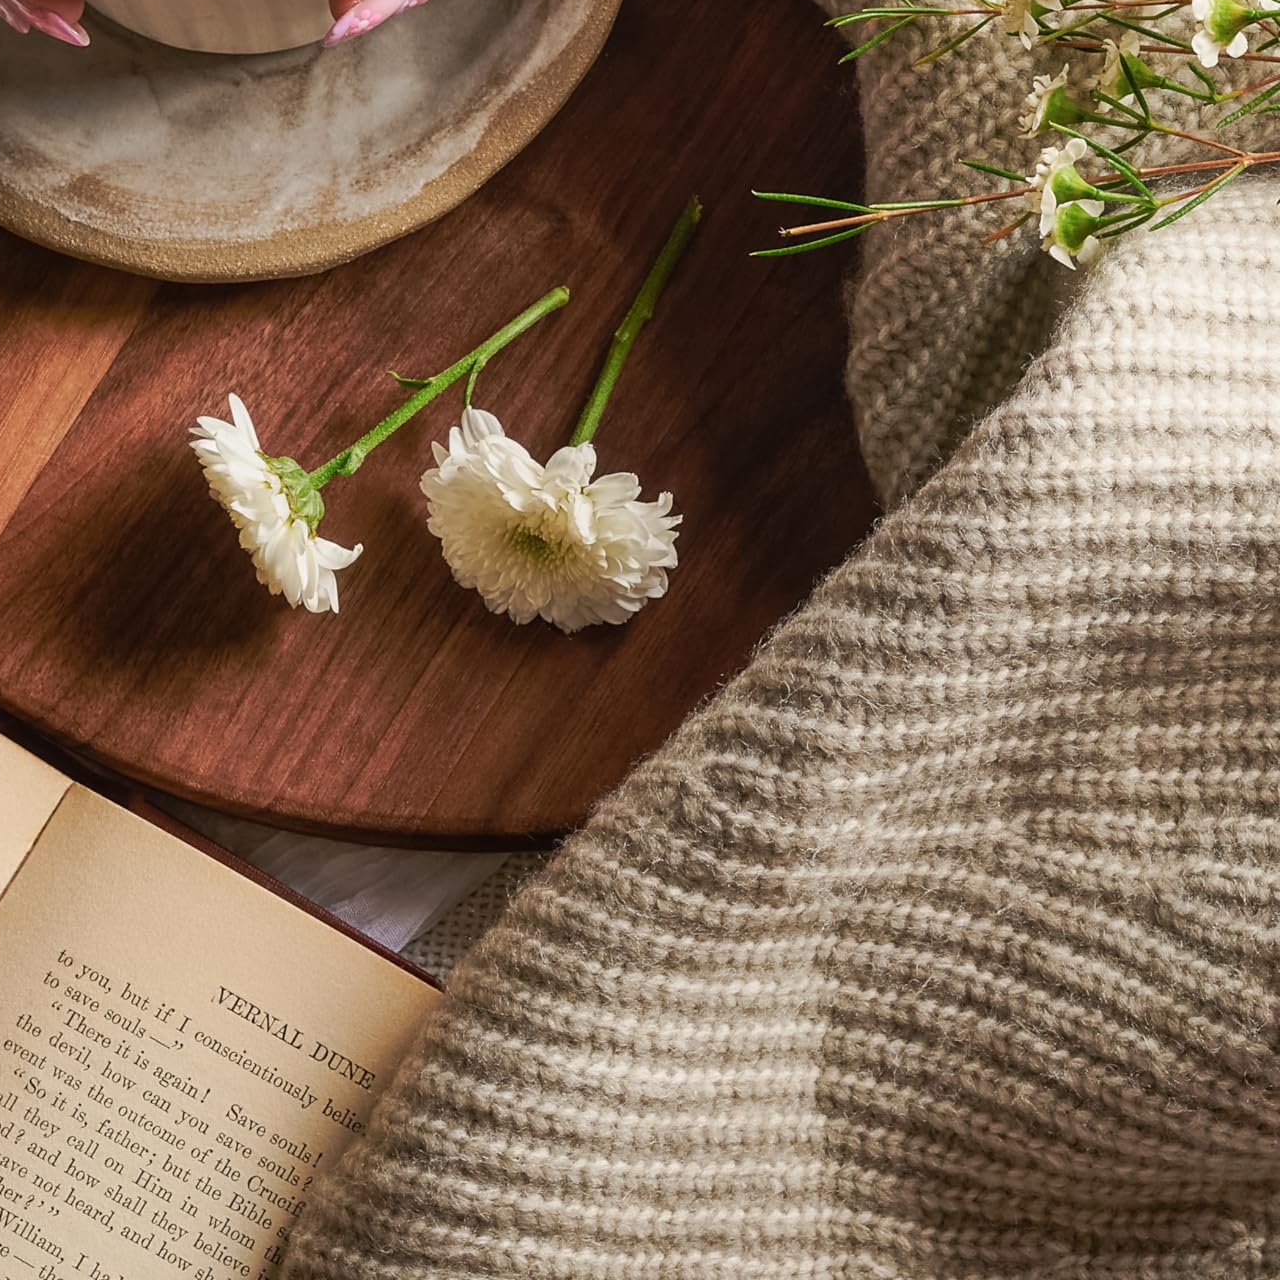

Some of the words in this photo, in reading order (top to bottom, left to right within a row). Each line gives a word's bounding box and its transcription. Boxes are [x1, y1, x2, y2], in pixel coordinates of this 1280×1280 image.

[43, 970, 59, 988] to
[63, 986, 99, 1012] save
[103, 1008, 146, 1038] souls
[57, 949, 73, 967] to
[74, 964, 111, 994] you,
[120, 982, 149, 1010] but
[153, 1002, 175, 1023] if
[175, 1015, 192, 1033] I
[194, 1031, 318, 1108] conscientiously
[210, 985, 303, 1049] VERNAL
[308, 1040, 375, 1089] DUNE
[3, 1039, 46, 1069] event
[52, 1065, 82, 1090] was
[87, 1084, 113, 1108] the
[118, 1105, 185, 1149] outcome
[190, 1147, 213, 1164] of
[214, 1158, 240, 1181] the
[16, 1014, 41, 1037] the
[48, 1031, 91, 1070] devil,
[100, 1060, 136, 1090] how
[142, 1090, 171, 1113] can
[174, 1110, 209, 1134] you
[215, 1132, 252, 1158] save
[113, 1039, 130, 1059] it
[132, 1050, 149, 1070] is
[225, 1103, 266, 1137] Save
[23, 1106, 60, 1138] they
[66, 1135, 99, 1159] call
[104, 1156, 124, 1175] on
[131, 1167, 172, 1203] Him
[179, 1195, 197, 1217] in
[208, 1214, 255, 1250] whom
[26, 1142, 61, 1166] and
[63, 1157, 100, 1188] how
[103, 1184, 147, 1216] shall
[150, 1210, 188, 1241] they
[192, 1231, 250, 1276] believe
[31, 1174, 60, 1197] not
[63, 1186, 114, 1232] heard,
[120, 1226, 155, 1250] and
[155, 1240, 192, 1271] how
[50, 1091, 66, 1111] it
[70, 1102, 87, 1128] is,
[161, 1153, 190, 1182] but
[194, 1176, 221, 1200] the
[225, 1191, 272, 1229] Bible
[71, 1252, 88, 1271] I
